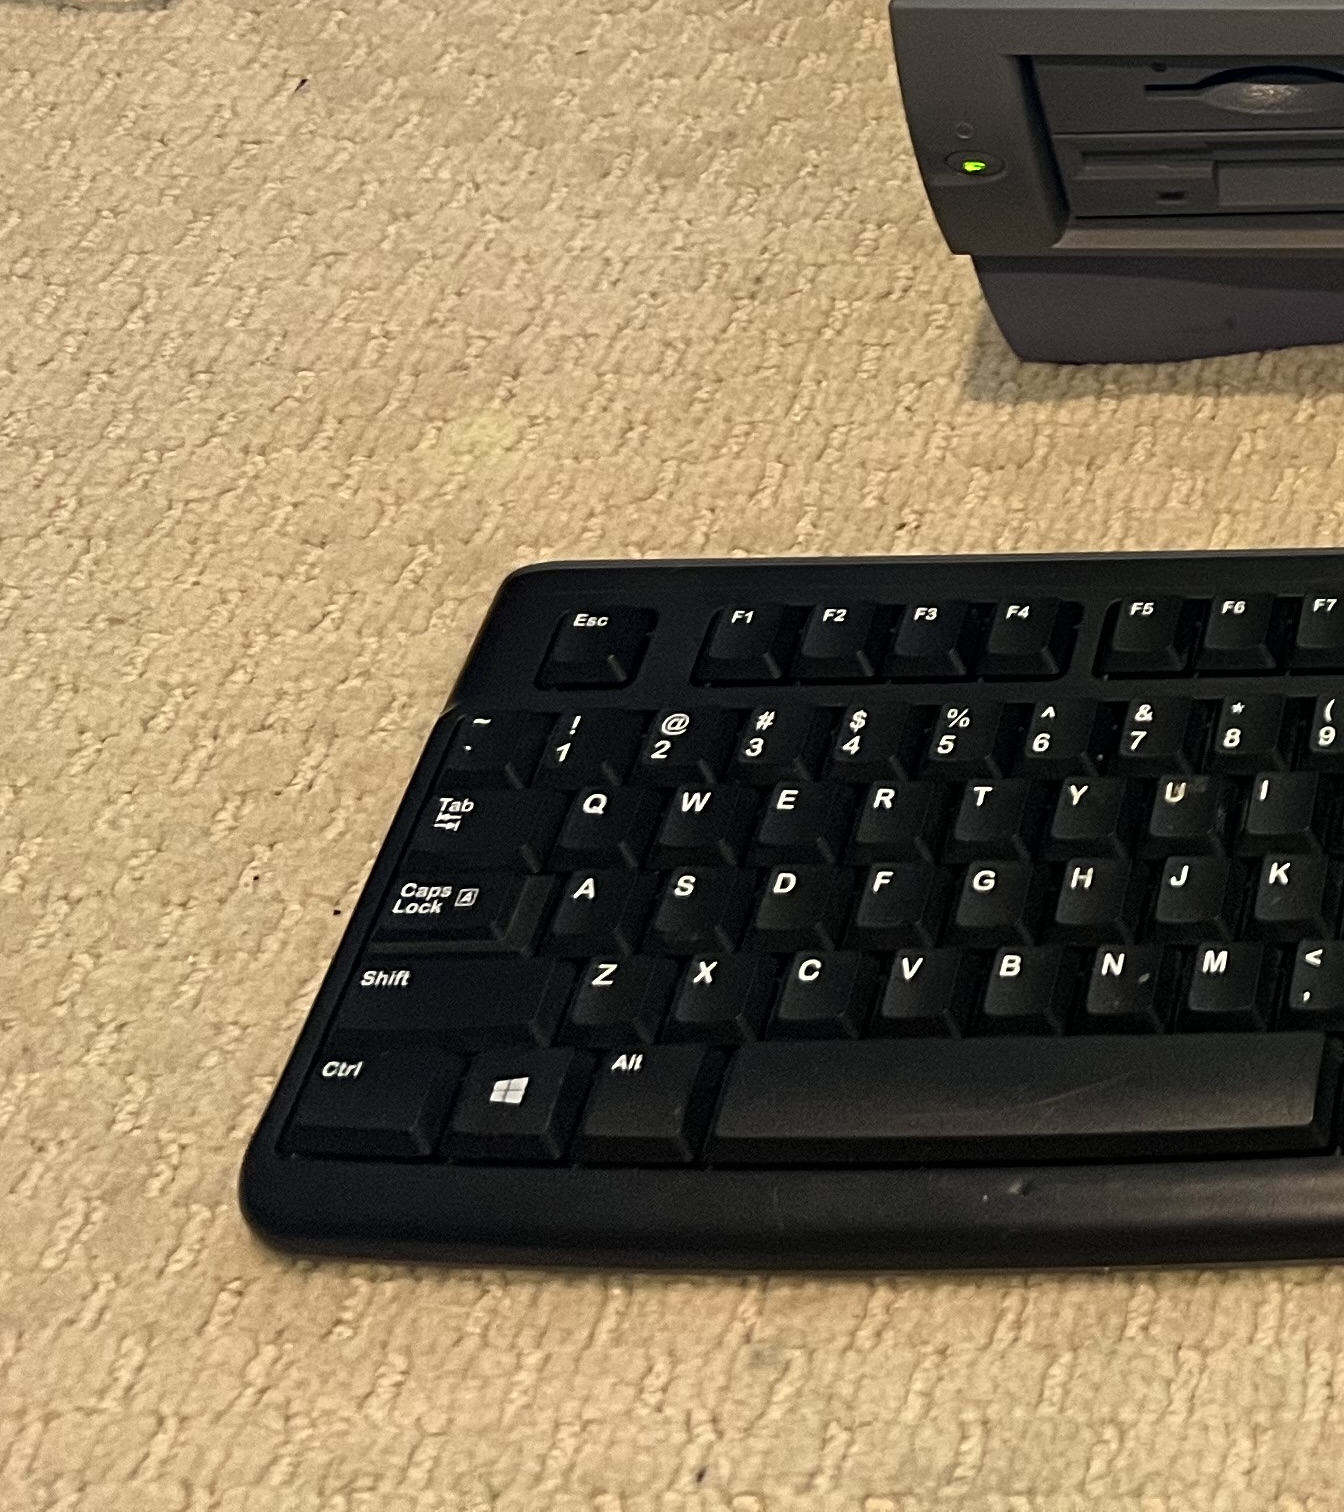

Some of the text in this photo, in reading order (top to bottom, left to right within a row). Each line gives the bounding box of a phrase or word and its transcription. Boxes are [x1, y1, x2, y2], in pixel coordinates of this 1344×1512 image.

[1005, 605, 1030, 619] F4
[1129, 601, 1155, 616] F5
[1221, 600, 1246, 614] F6
[1312, 598, 1338, 612] F7
[572, 613, 609, 627] Esc
[731, 610, 754, 624] F1
[822, 608, 847, 622] F2
[913, 607, 938, 621] F3
[439, 797, 475, 813] Tab
[397, 882, 453, 903] Caps
[391, 898, 443, 914] Lock
[360, 970, 410, 987] Shift
[321, 1060, 363, 1078] Ctrl
[610, 1053, 643, 1071] Alt
